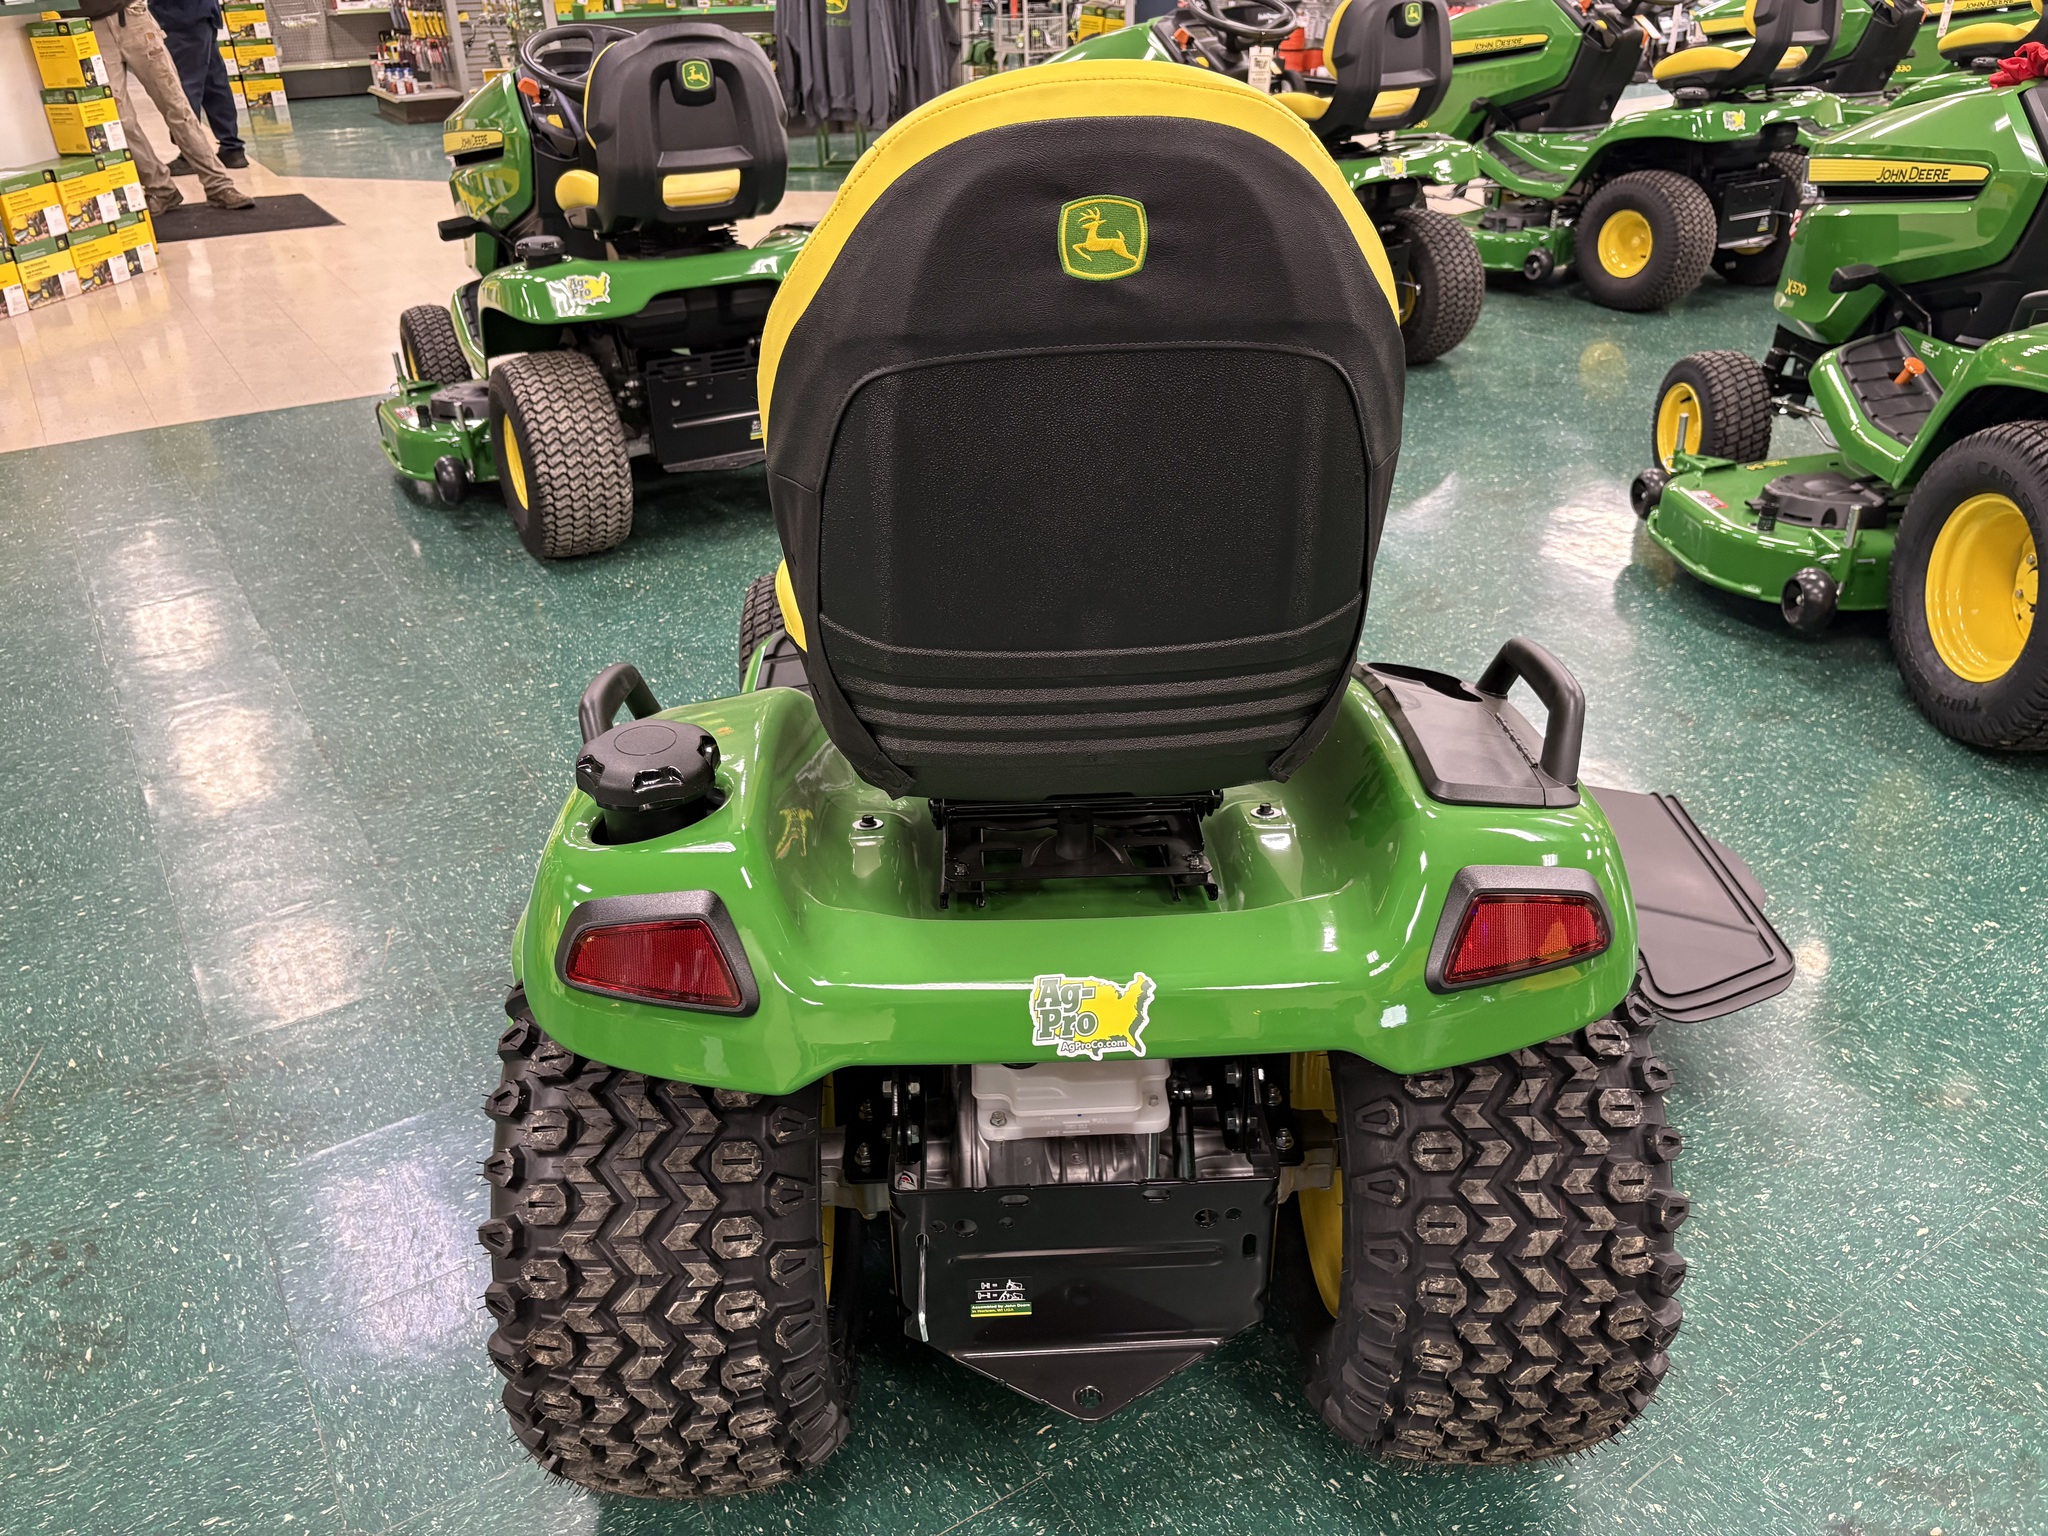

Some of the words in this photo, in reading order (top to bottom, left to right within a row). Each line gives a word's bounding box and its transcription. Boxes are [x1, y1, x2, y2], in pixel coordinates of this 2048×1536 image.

[1472, 42, 1494, 52] JOHN
[1495, 38, 1524, 49] DEERE
[1876, 166, 1908, 181] JOHN
[1908, 166, 1951, 181] DEERE
[571, 288, 592, 300] Pro
[1785, 278, 1807, 297] X570
[1034, 977, 1096, 1014] Ag-
[1036, 1008, 1099, 1041] Pro
[1061, 1039, 1128, 1054] AgProCo.com
